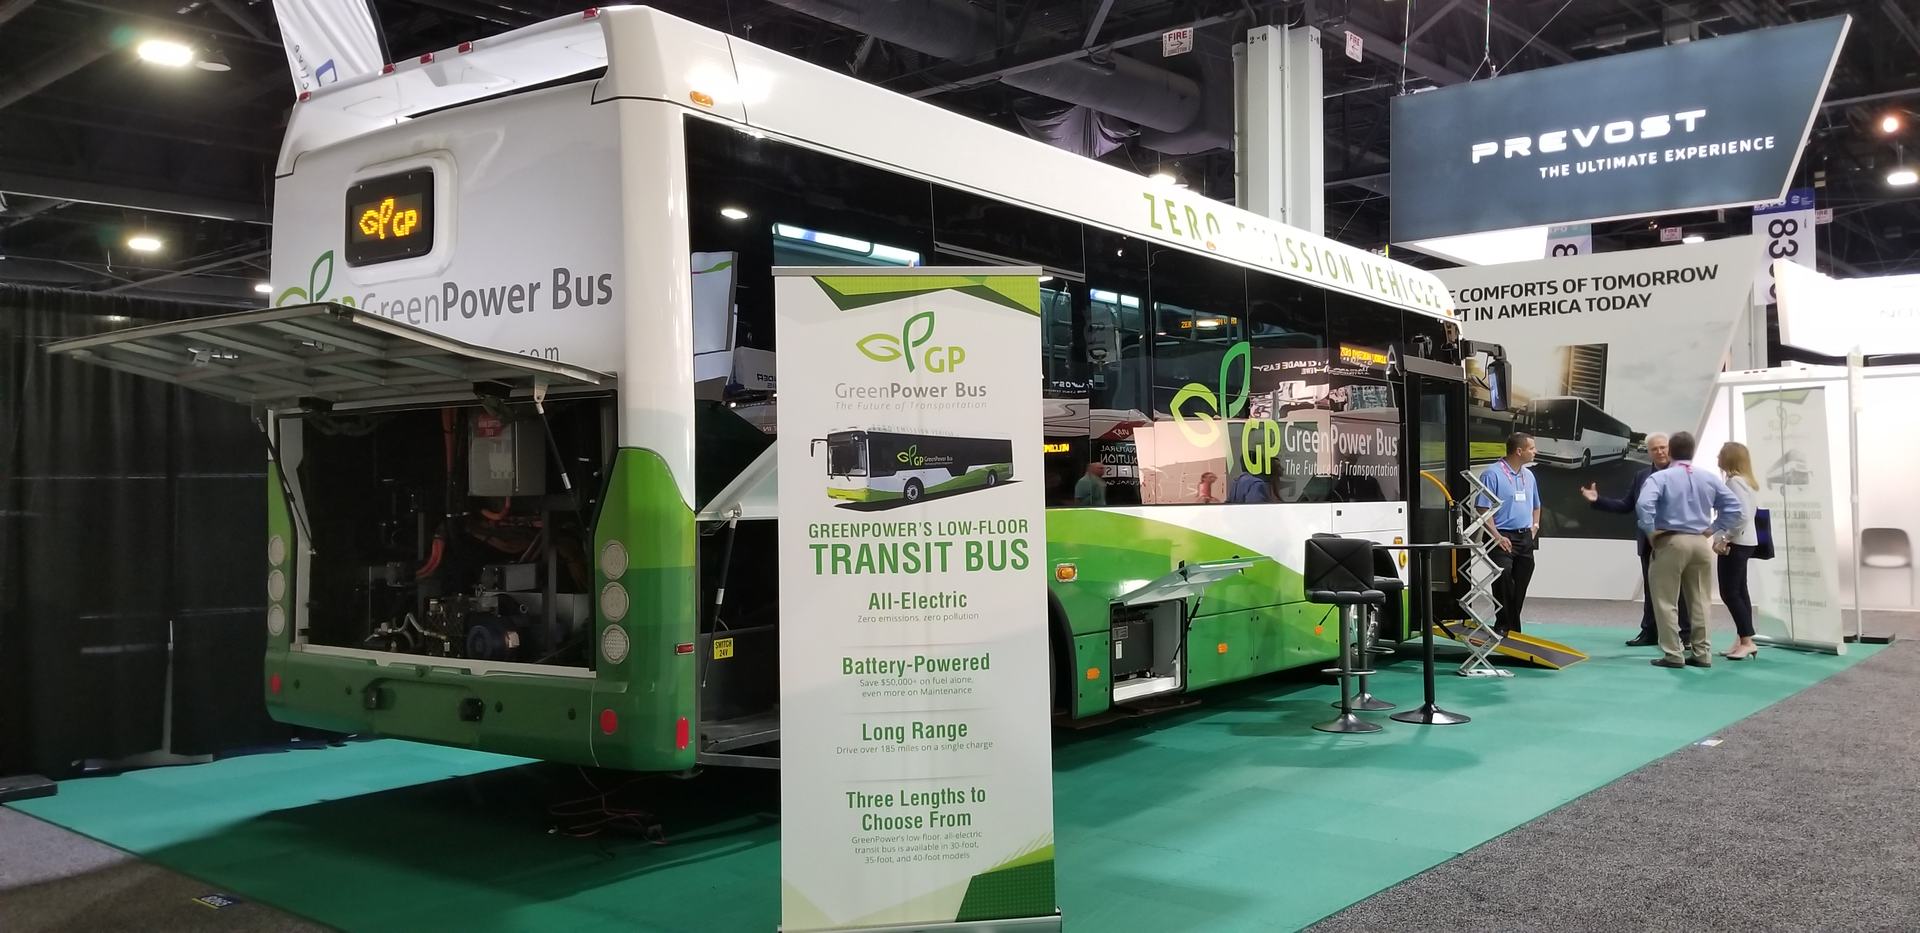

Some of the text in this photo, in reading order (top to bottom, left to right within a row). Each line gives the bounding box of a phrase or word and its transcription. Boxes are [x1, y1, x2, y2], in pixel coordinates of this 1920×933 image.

[1168, 30, 1188, 42] FIRE
[1471, 108, 1706, 164] PREVOST
[1539, 135, 1776, 179] THE ULTIMATE EXPERIENCE
[1236, 222, 1356, 286] ISSION
[552, 267, 613, 310] Bus
[1459, 280, 1559, 304] COMFORTS
[1562, 277, 1589, 295] OF
[1591, 264, 1720, 292] TOMORROW
[1475, 305, 1494, 322] IN
[1497, 299, 1583, 320] AMERICA
[1585, 293, 1653, 313] TODAY
[924, 346, 966, 374] GP
[835, 382, 987, 399] GreenPower Bus
[835, 401, 988, 412] The Future of Transportation
[1242, 418, 1281, 475] GP
[1284, 421, 1372, 456] GreenPower
[1376, 427, 1399, 457] Bus
[913, 456, 924, 466] GP
[1285, 459, 1398, 480] The Future of Transportation
[808, 519, 1029, 539] GREENPOWER'S LOW-FLOOR
[809, 538, 1030, 576] TRANSIT BUS
[868, 591, 968, 611] All-Electric
[857, 615, 877, 623] Zero
[923, 614, 941, 622] zero
[943, 611, 979, 623] pollution
[715, 640, 732, 649] SWITCH
[842, 653, 991, 678] Battery-Powered
[859, 679, 879, 687] Save
[880, 677, 918, 687] $50,000+
[932, 676, 948, 685] fuel
[949, 676, 974, 686] alone,
[862, 686, 973, 698] even more on Maintenance
[862, 721, 968, 744] Long Range
[836, 745, 858, 755] Drive
[881, 744, 896, 753] 185
[898, 743, 919, 753] miles
[941, 742, 964, 753] single
[966, 740, 994, 751] charge
[846, 786, 987, 809] Three Lengths to
[862, 811, 972, 832] Choose From
[851, 834, 905, 845] GreenPower's
[944, 830, 983, 840] all-electric
[855, 845, 880, 854] transit
[881, 844, 896, 853] bus
[905, 843, 939, 853] available
[941, 842, 948, 850] in
[950, 840, 980, 850] 30-foot,
[865, 851, 970, 865] 35-foot, and 40-foot models
